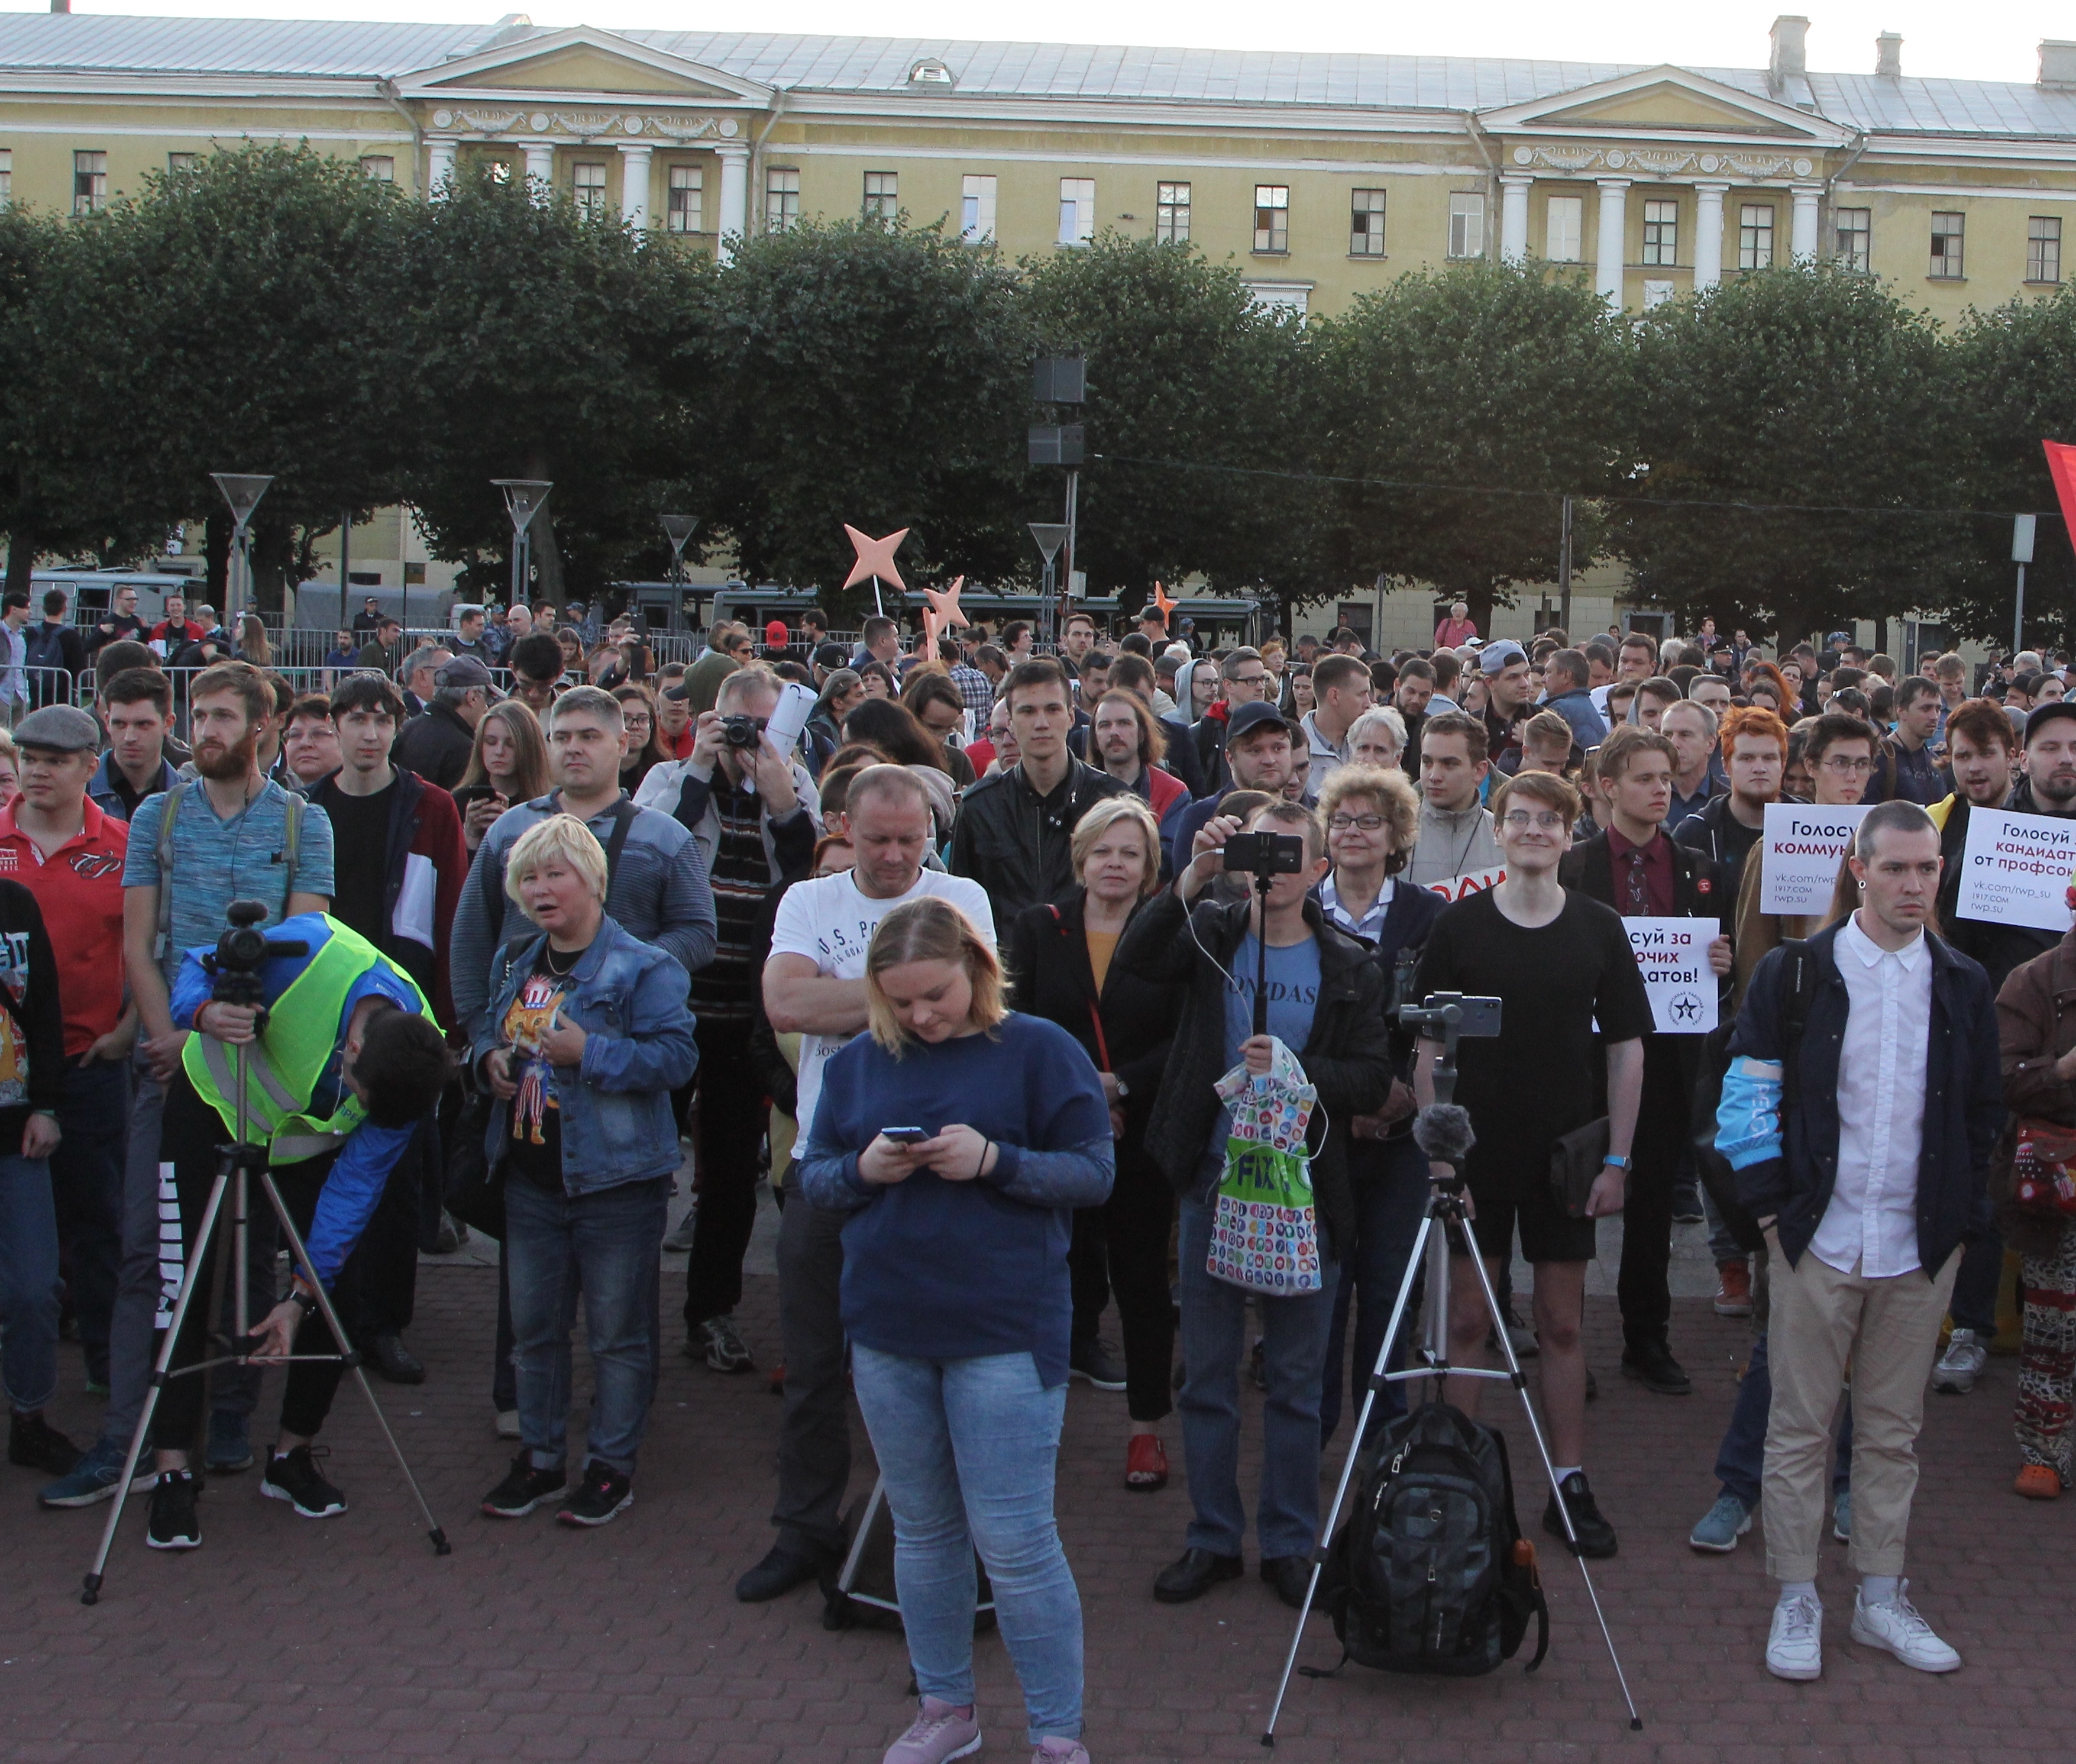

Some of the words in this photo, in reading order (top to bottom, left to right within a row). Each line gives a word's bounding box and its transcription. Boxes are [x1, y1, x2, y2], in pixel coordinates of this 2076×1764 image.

[2003, 823, 2069, 845] Голосуй
[1974, 855, 1994, 866] от
[1974, 881, 2051, 898] vk.com/rwp_su
[1774, 895, 1807, 903] rwp.su
[1972, 893, 2009, 903] 1917.COM
[1971, 903, 2003, 913] rwp.su
[1671, 933, 1692, 944] за
